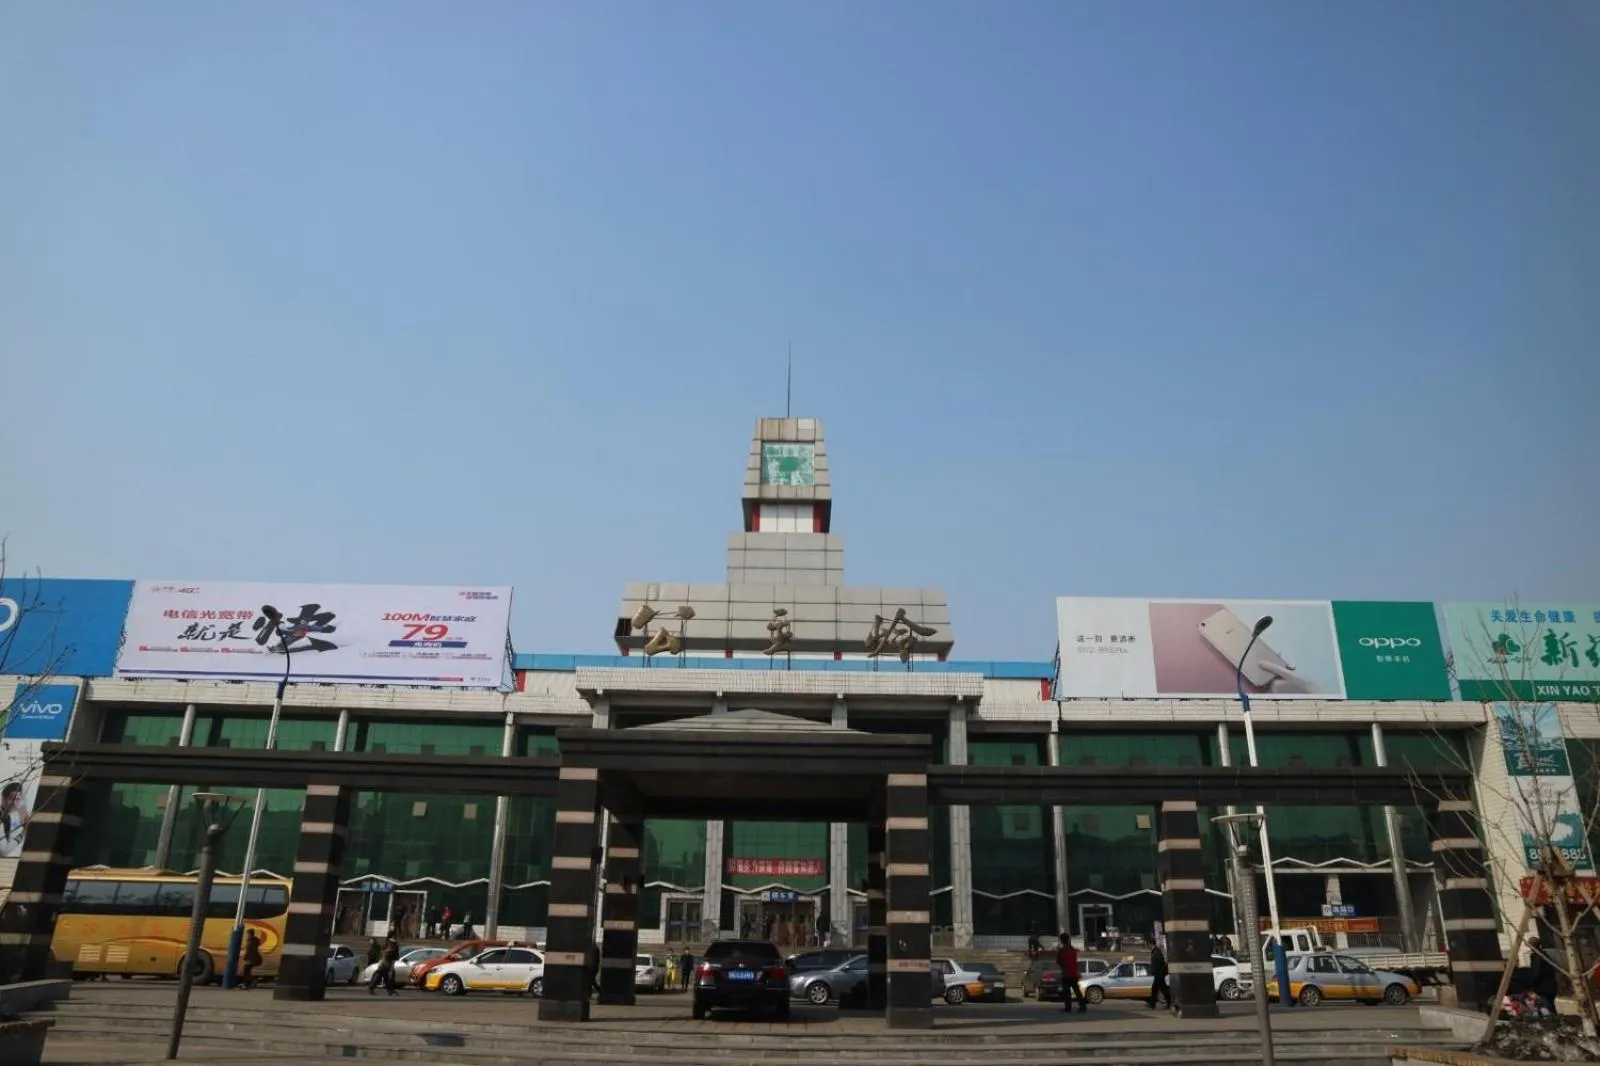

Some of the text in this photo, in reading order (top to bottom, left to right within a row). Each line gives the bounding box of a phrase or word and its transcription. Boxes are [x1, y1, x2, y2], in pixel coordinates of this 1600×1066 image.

[163, 609, 254, 620] 电信光宽带
[401, 623, 449, 640] 79
[1537, 685, 1560, 695] XIN
[1563, 685, 1591, 695] YAO
[20, 701, 63, 714] vivo
